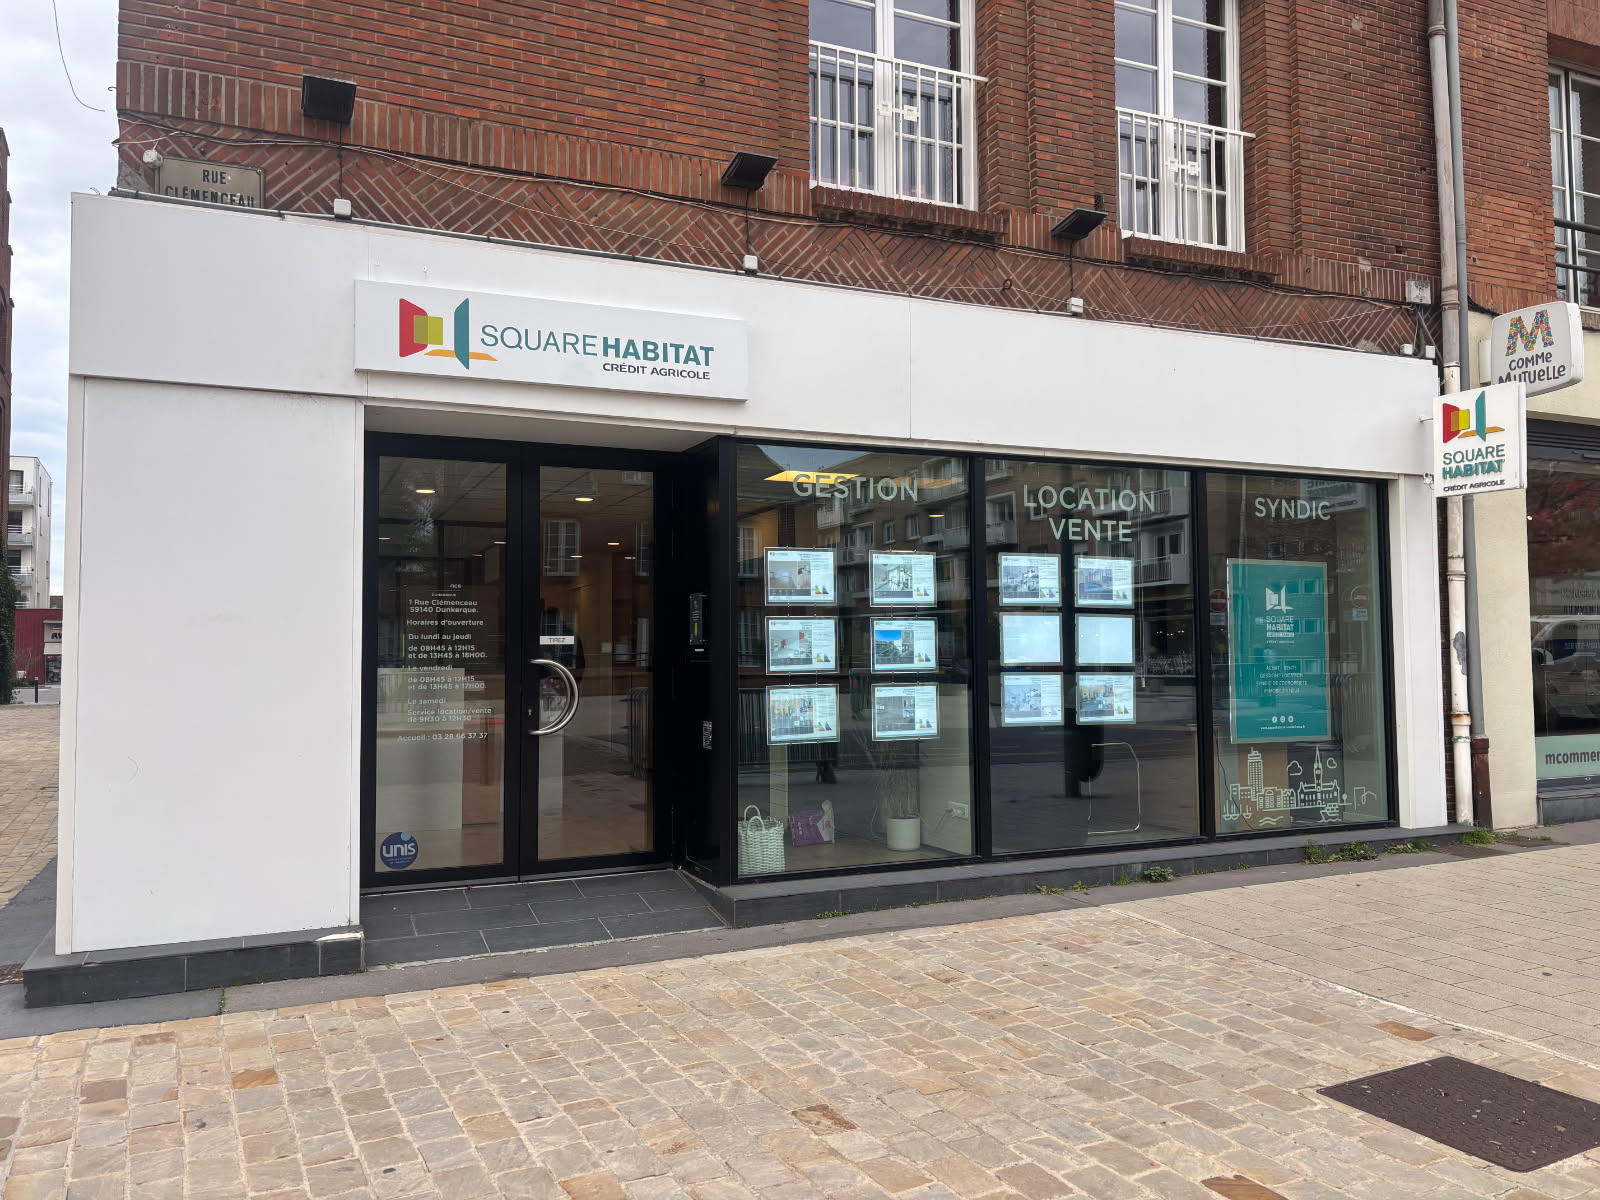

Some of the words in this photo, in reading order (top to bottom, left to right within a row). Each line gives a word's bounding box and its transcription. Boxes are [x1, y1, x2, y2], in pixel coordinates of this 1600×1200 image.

[203, 169, 227, 185] RUE
[480, 324, 599, 357] SQUARE
[602, 336, 714, 367] HABITAT
[602, 362, 648, 376] CRÉDIT
[650, 367, 711, 380] AGRICOLE
[1443, 444, 1505, 465] SQUARE
[1442, 459, 1503, 480] HABITAT
[792, 474, 918, 501] GESTION
[1469, 480, 1505, 489] AGRICOLE
[1023, 485, 1155, 512] LOCATION
[1255, 497, 1331, 520] SYNDIC
[1049, 518, 1133, 542] VENTE
[453, 633, 472, 641] jeudi
